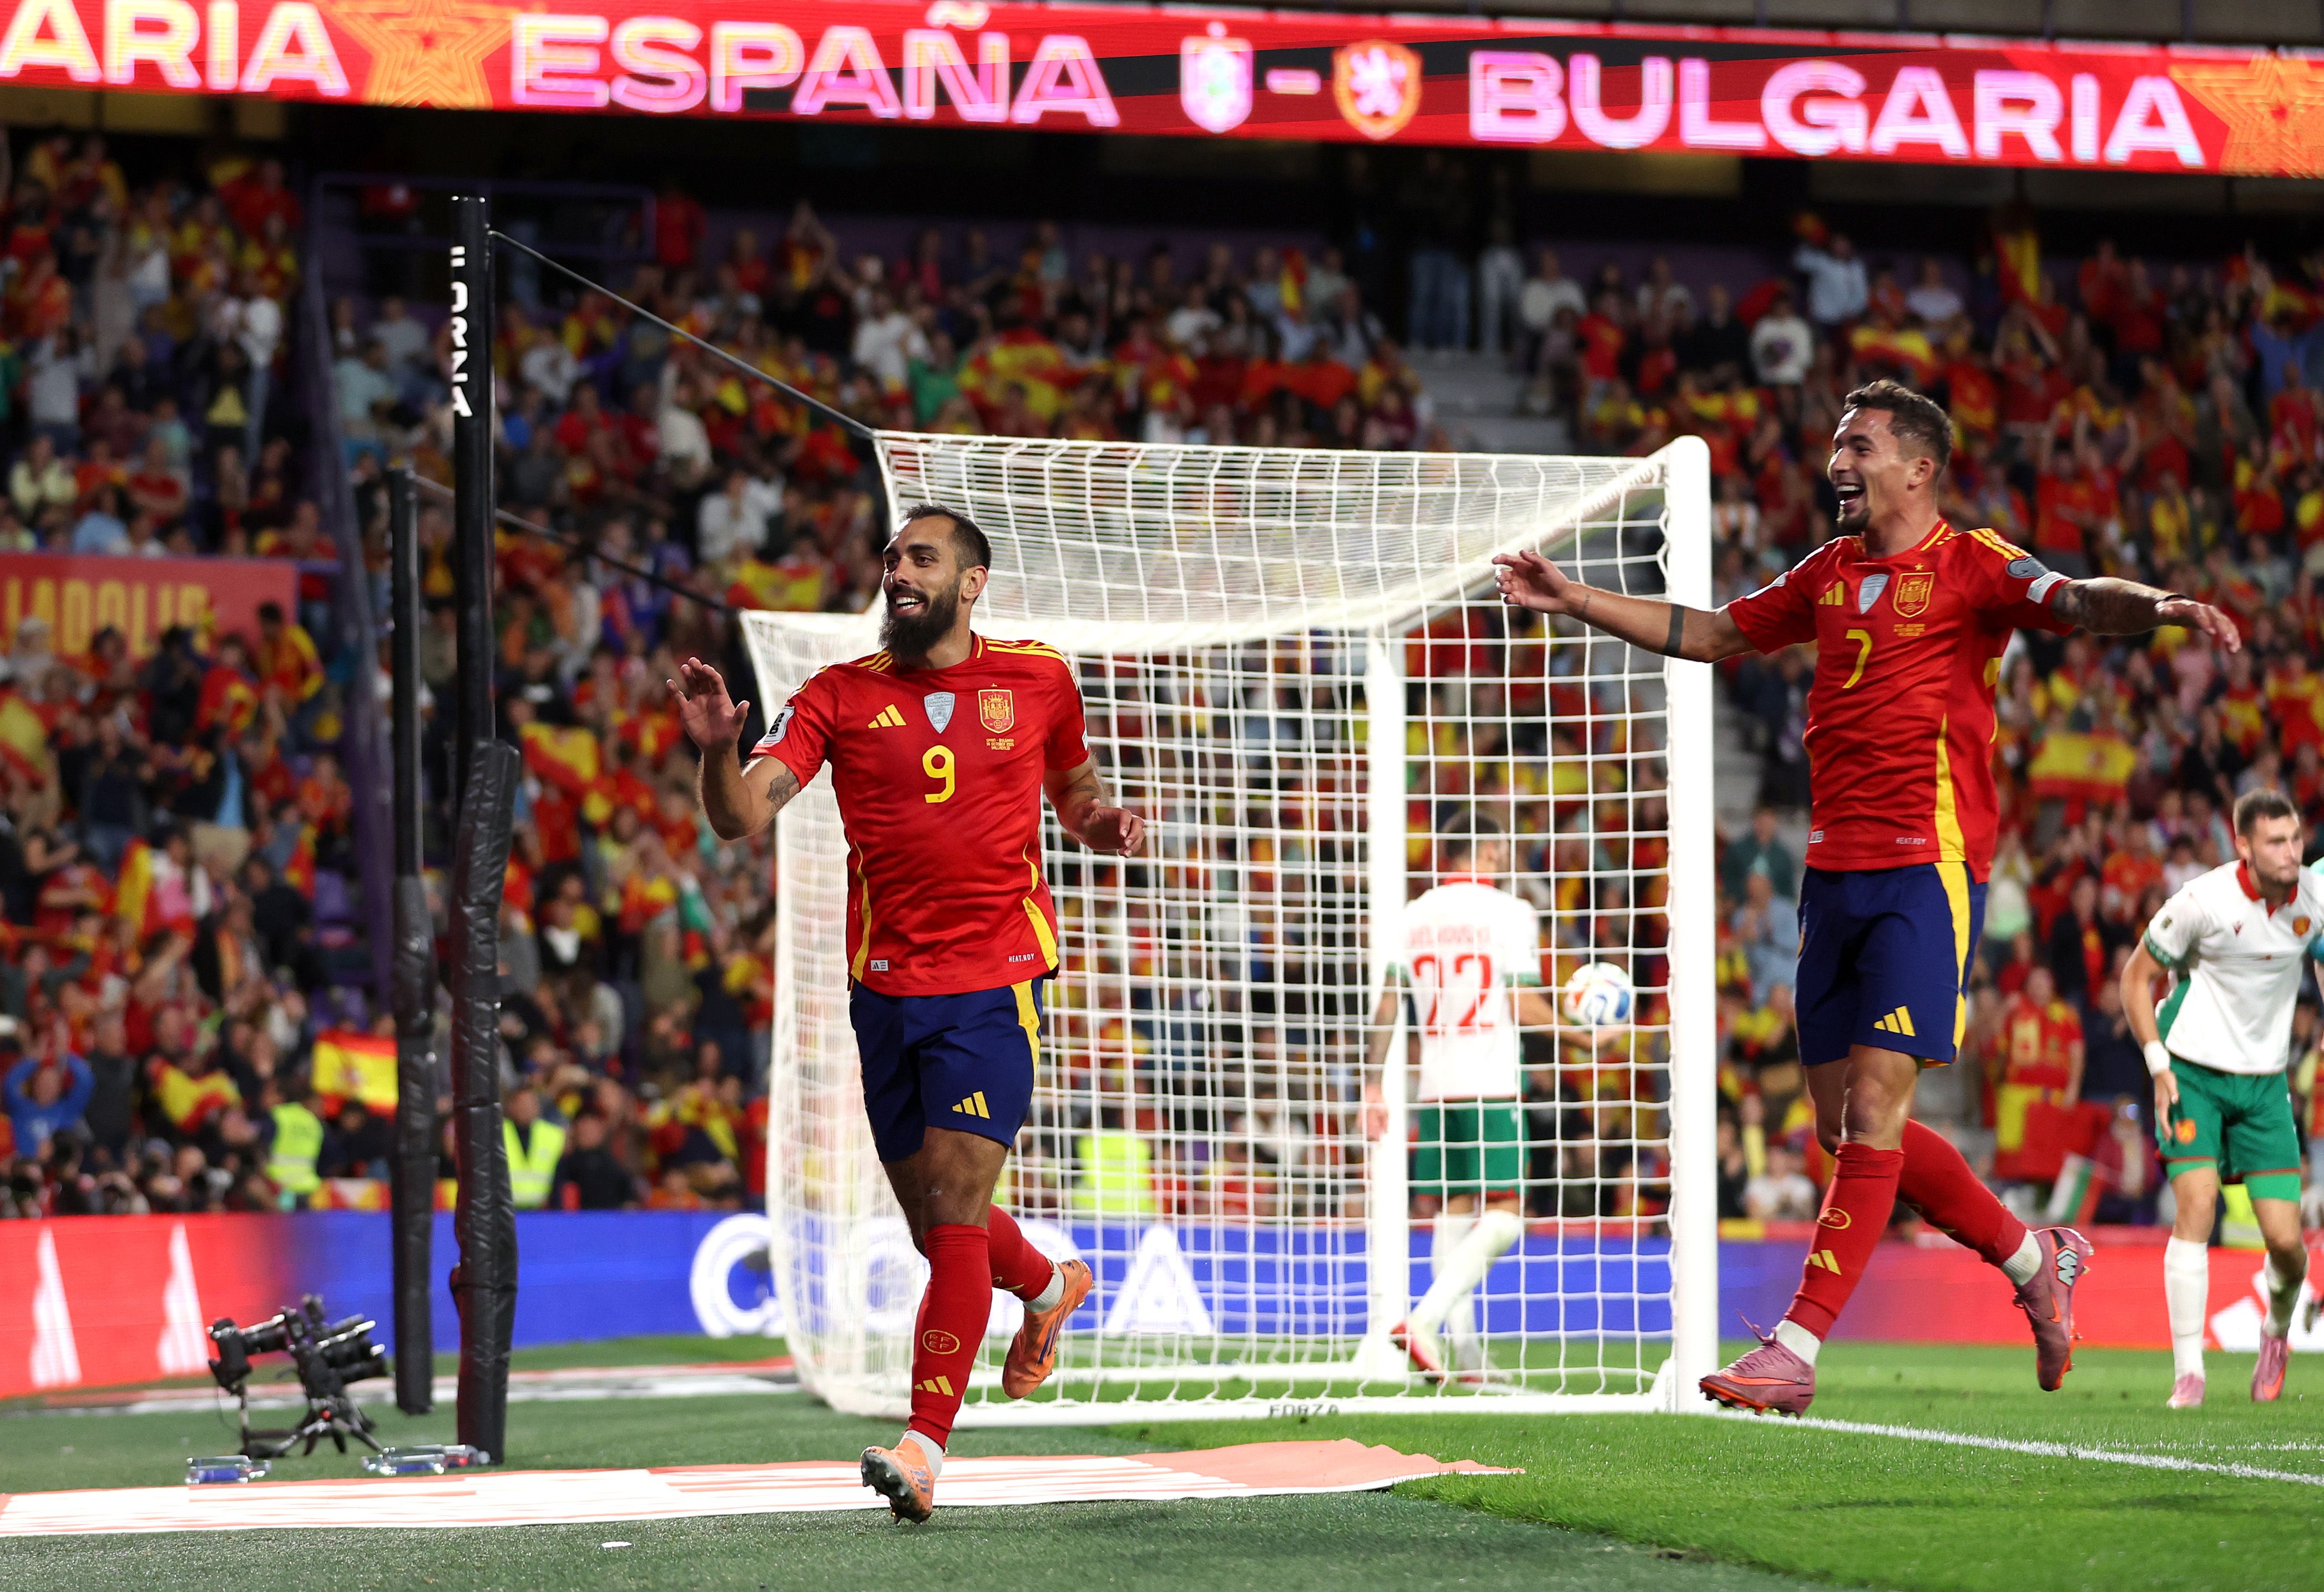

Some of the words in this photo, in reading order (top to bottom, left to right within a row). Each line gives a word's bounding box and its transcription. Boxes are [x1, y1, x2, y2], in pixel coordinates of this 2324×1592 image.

[0, 0, 351, 96] ARIA
[511, 1, 1120, 127] ESPAÑA
[1468, 50, 2207, 168] BULGARIA
[1842, 629, 1873, 689] 7
[922, 745, 956, 803] 9
[1008, 953, 1034, 963] HEAT.RDY
[1413, 953, 1494, 1037] 22
[1269, 1403, 1340, 1417] FORZA
